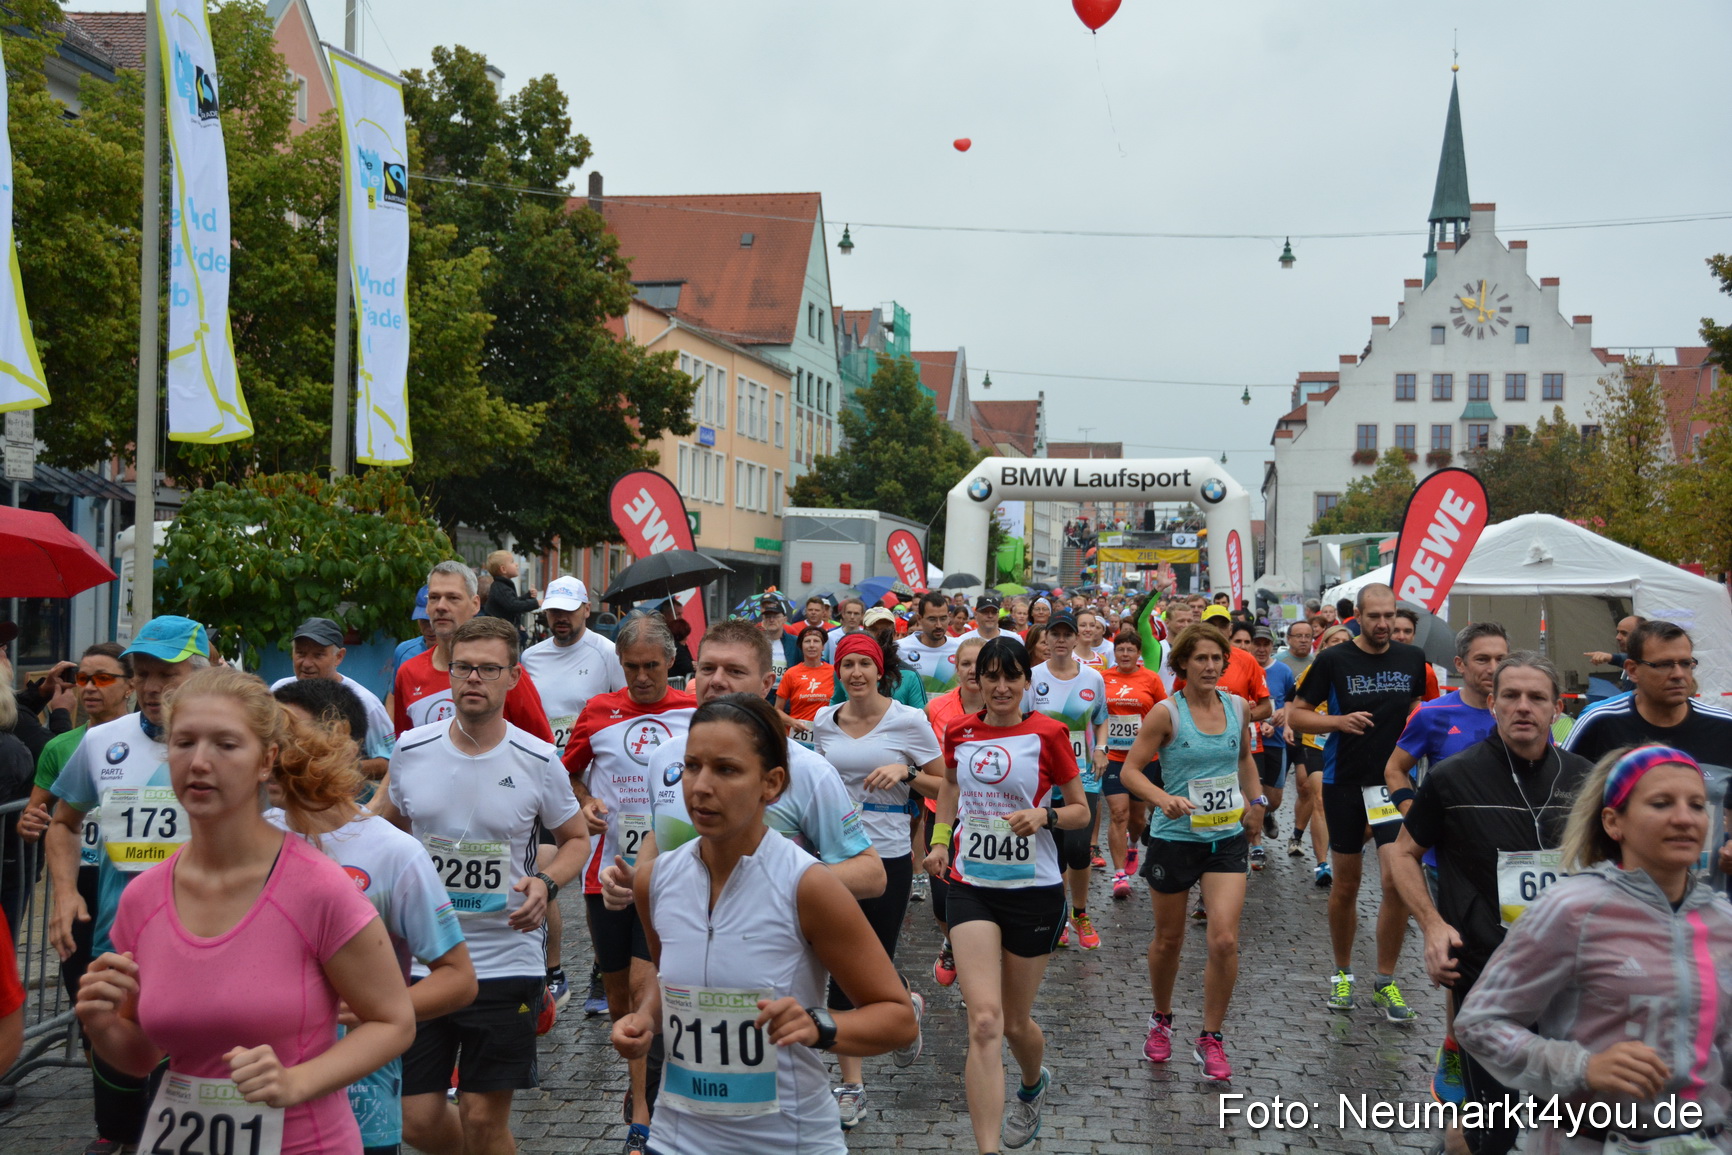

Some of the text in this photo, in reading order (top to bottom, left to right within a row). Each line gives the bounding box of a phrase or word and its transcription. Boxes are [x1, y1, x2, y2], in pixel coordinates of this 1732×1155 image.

[1001, 466, 1191, 491] BMW Laufsport
[1137, 551, 1160, 560] ZIEL
[1398, 488, 1475, 609] REWE
[1110, 723, 1139, 737] 2295
[101, 768, 125, 776] PARTL
[612, 774, 644, 784] LAUFEN
[121, 806, 178, 838] 173
[1212, 815, 1229, 825] Lisa
[125, 846, 166, 859] Martin
[459, 842, 503, 854] BOCK
[968, 832, 1030, 861] 2048
[431, 855, 502, 890] 2285
[698, 991, 761, 1008] BOCK
[669, 1014, 765, 1067] 2110
[692, 1077, 729, 1097] Nina
[150, 1107, 264, 1155] 2201
